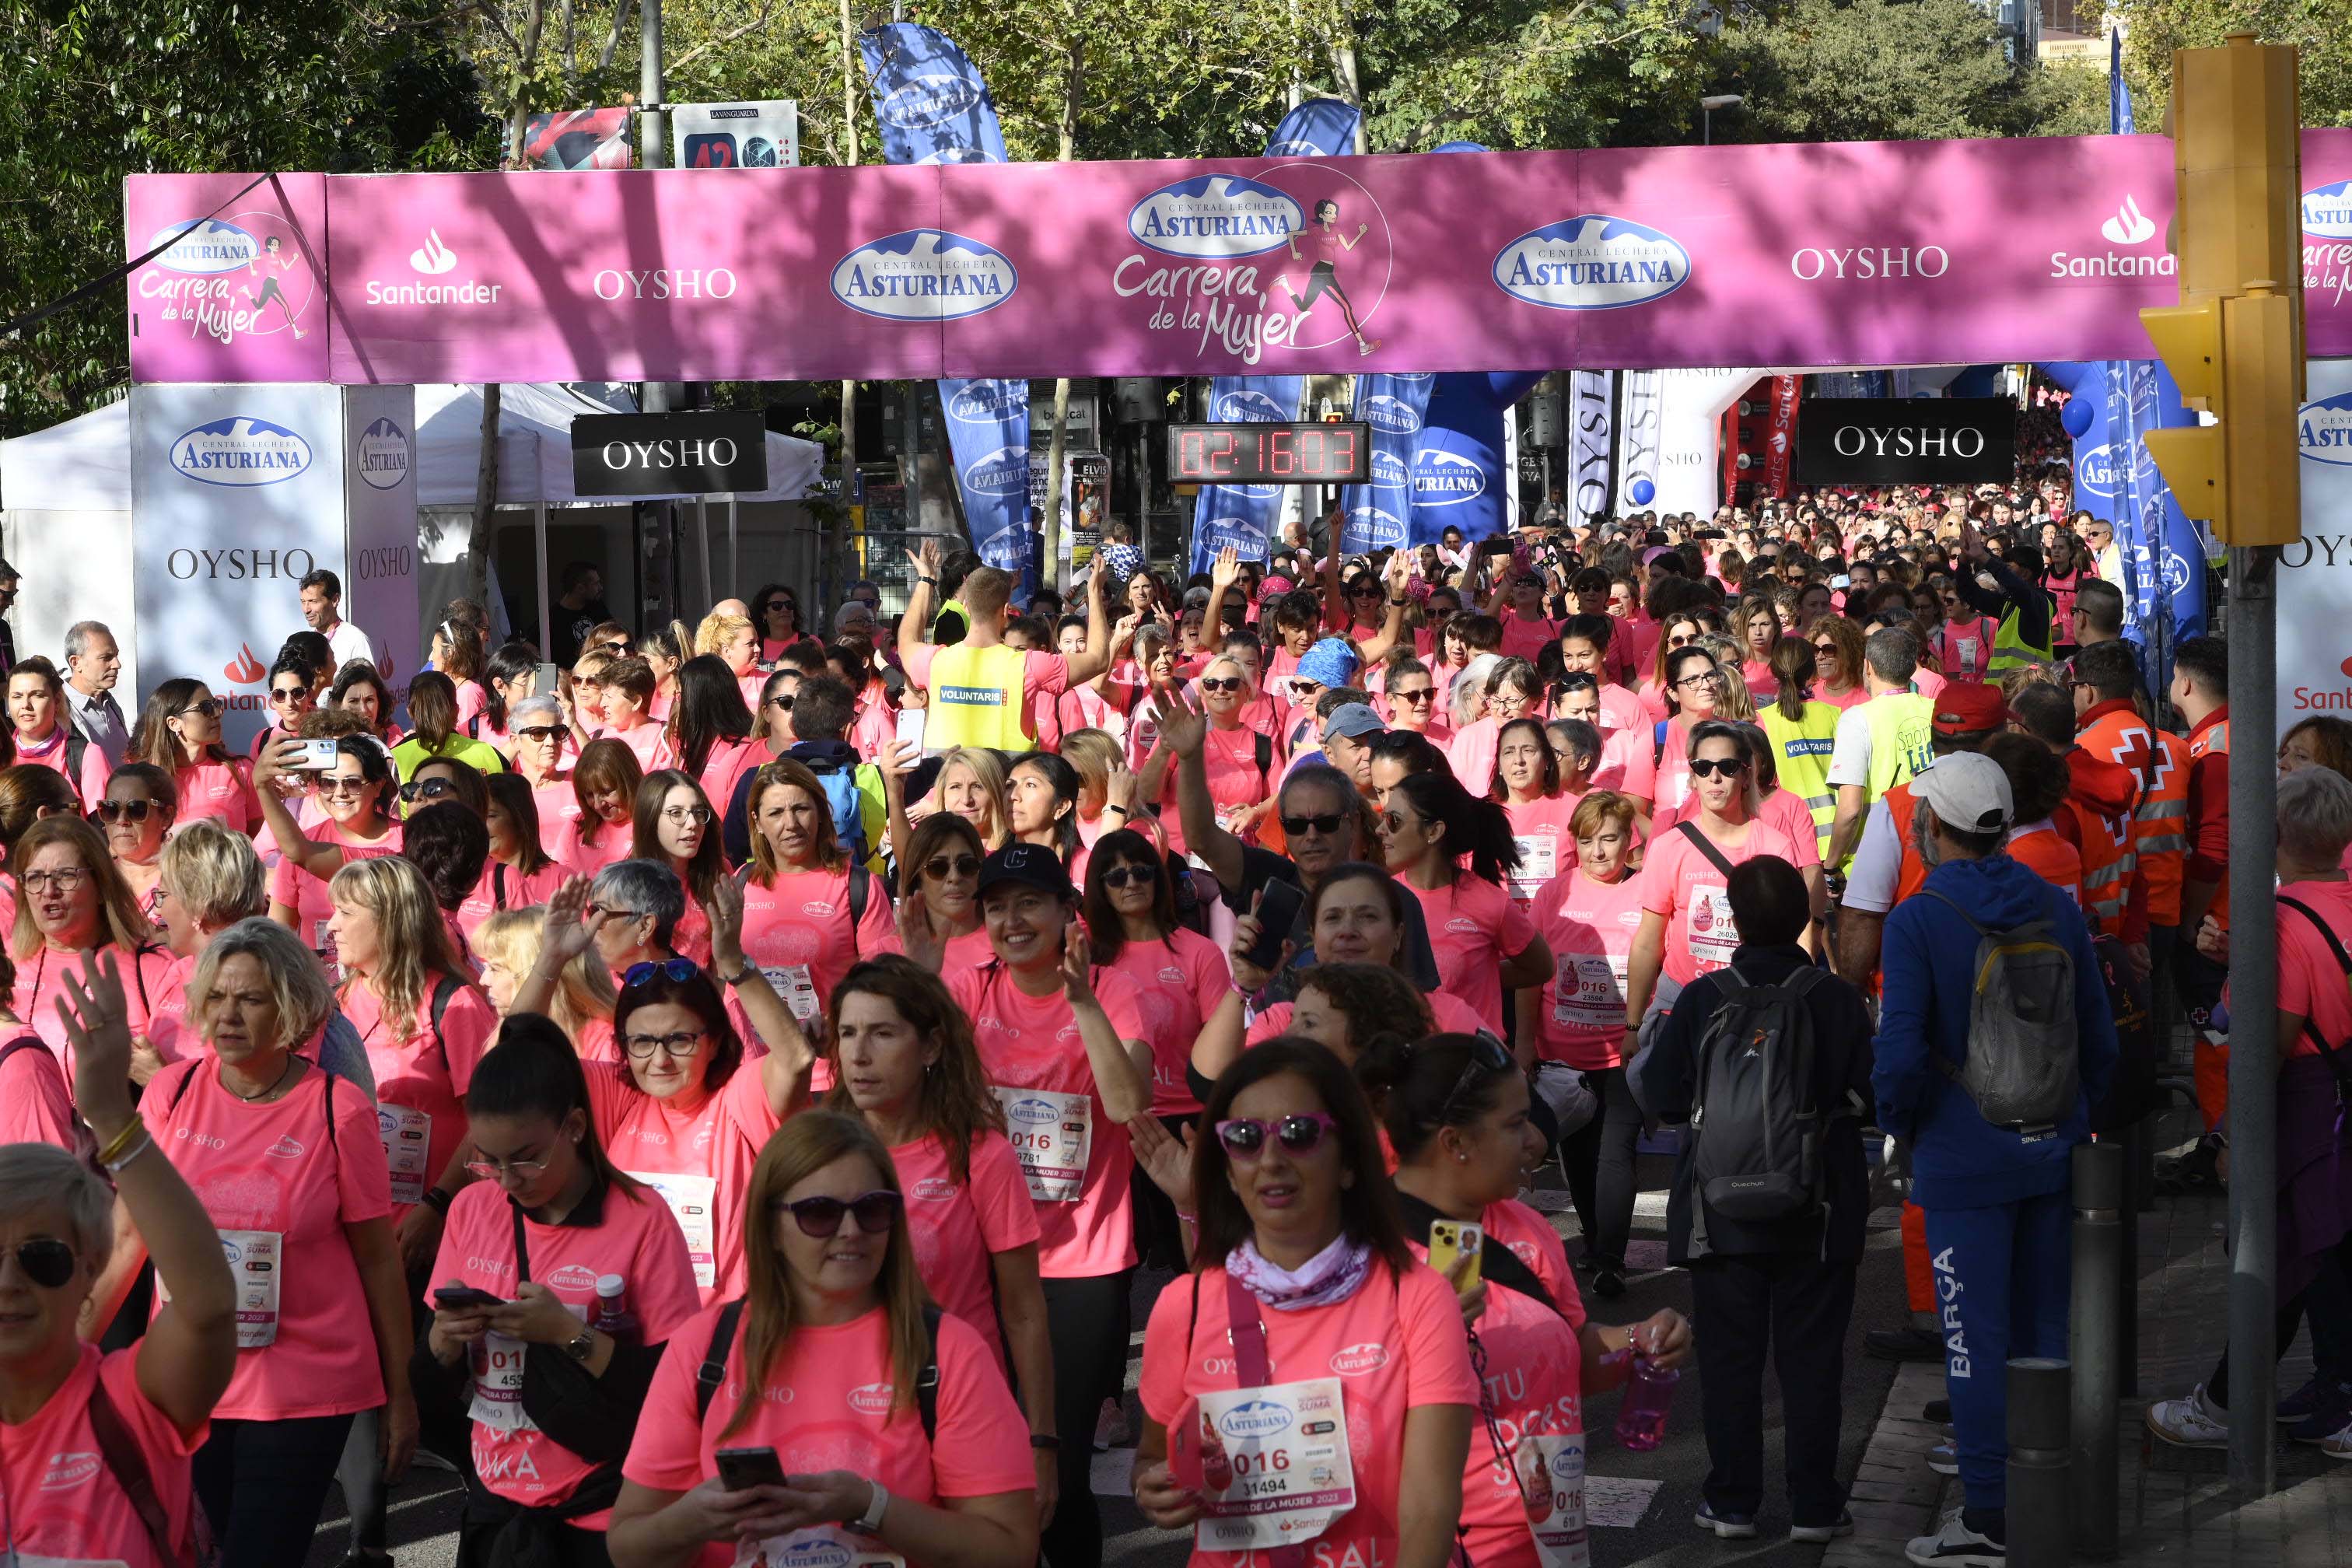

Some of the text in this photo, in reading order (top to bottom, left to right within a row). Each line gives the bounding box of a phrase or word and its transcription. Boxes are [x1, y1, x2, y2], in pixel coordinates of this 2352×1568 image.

[1142, 206, 1290, 238] ASTURIANA
[1507, 250, 1675, 286] ASTURIANA
[1791, 246, 1948, 280] OYSHO
[2051, 252, 2176, 277] Santand
[138, 270, 229, 299] Carrera
[593, 268, 737, 299] OYSHO
[845, 264, 1003, 297] ASTURIANA
[1113, 254, 1258, 297] Carrera
[2323, 267, 2336, 288] la
[366, 281, 501, 305] Santander
[161, 296, 265, 345] de la Mujer
[1149, 292, 1312, 366] de la Mujer
[1834, 425, 1983, 457] OYSHO
[182, 443, 301, 468] ASTURIANA
[362, 445, 406, 471] ASTURIANA
[602, 437, 736, 468] OYSHO
[1181, 432, 1354, 474] 02:16:03
[1083, 466, 1108, 474] ELVIS
[167, 548, 313, 579] OYSHO
[359, 544, 410, 579] OYSHO
[941, 690, 1000, 702] VOLUNTARIS
[1686, 871, 1719, 880] OYSHO
[744, 901, 775, 910] OYSHO
[1716, 917, 1732, 928] 01
[1717, 930, 1738, 939] 26026
[1581, 982, 1608, 992] 016
[1013, 1108, 1056, 1120] ASTURIANA
[177, 1128, 226, 1150] OYSHO
[628, 1125, 667, 1145] OYSHO
[1011, 1132, 1052, 1150] 016
[2021, 1136, 2041, 1144] SINCE
[467, 1256, 513, 1278] OYSHO
[550, 1273, 595, 1284] ASTURIANA
[1933, 1247, 1972, 1379] BARÇA
[492, 1350, 522, 1369] 01
[1335, 1355, 1386, 1370] ASTURIANA
[1484, 1368, 1524, 1405] TU
[1298, 1400, 1332, 1412] SUMA
[1226, 1414, 1287, 1432] ASTURIANA
[1234, 1448, 1290, 1475] 016
[518, 1483, 545, 1492] 2023
[1244, 1478, 1286, 1496] 31494
[1264, 1500, 1276, 1510] LA
[1279, 1496, 1313, 1508] MUJER
[1316, 1493, 1339, 1504] 2023
[1556, 1489, 1582, 1510] 016
